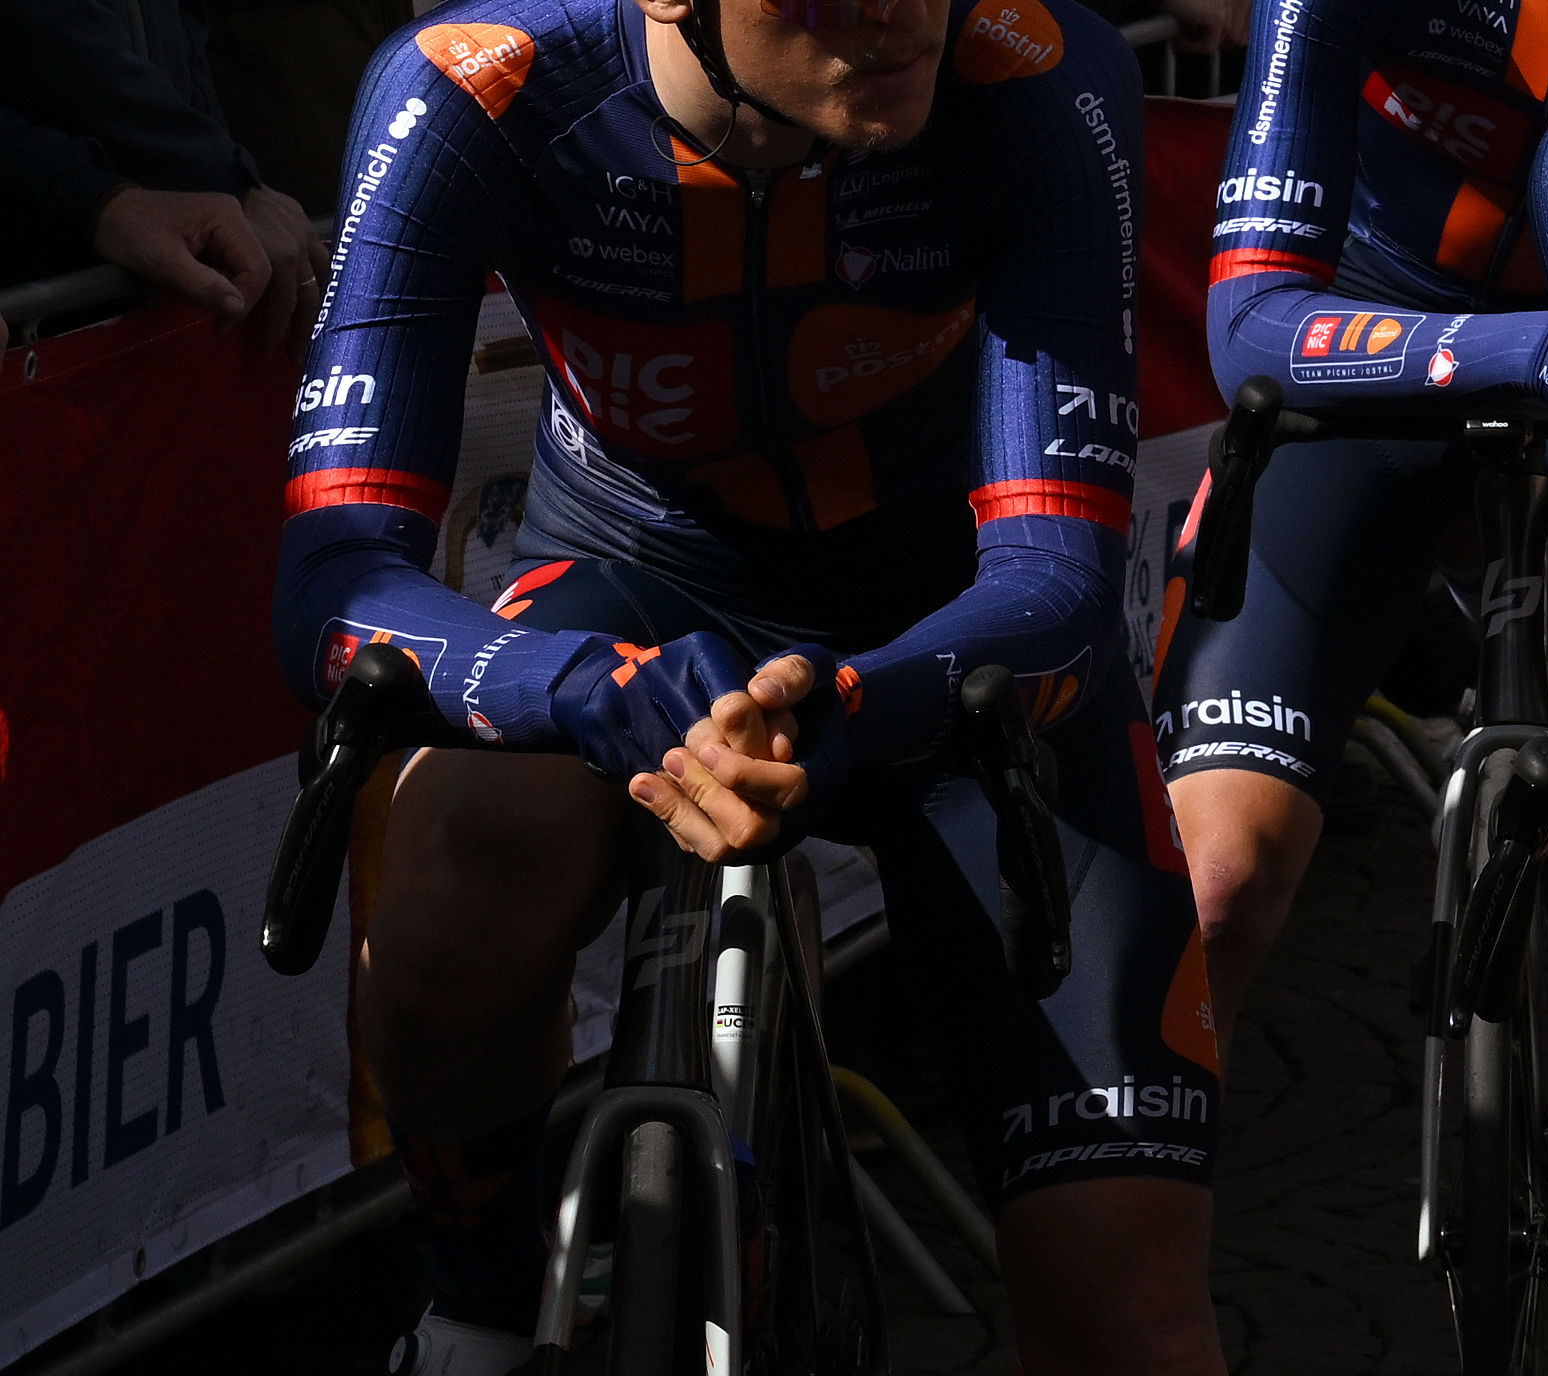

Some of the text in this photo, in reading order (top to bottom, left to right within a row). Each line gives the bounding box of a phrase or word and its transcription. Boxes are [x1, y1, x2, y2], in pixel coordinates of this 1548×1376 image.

[970, 15, 1055, 67] postnl
[605, 170, 674, 206] IG&H
[309, 141, 398, 341] dsm-firmenich
[599, 245, 675, 267] webex
[880, 243, 951, 275] Nalini
[1180, 690, 1312, 742] raisin
[0, 885, 227, 1233] BIER
[1049, 1075, 1208, 1127] raisin
[1000, 1141, 1208, 1191] LAPIERRE
